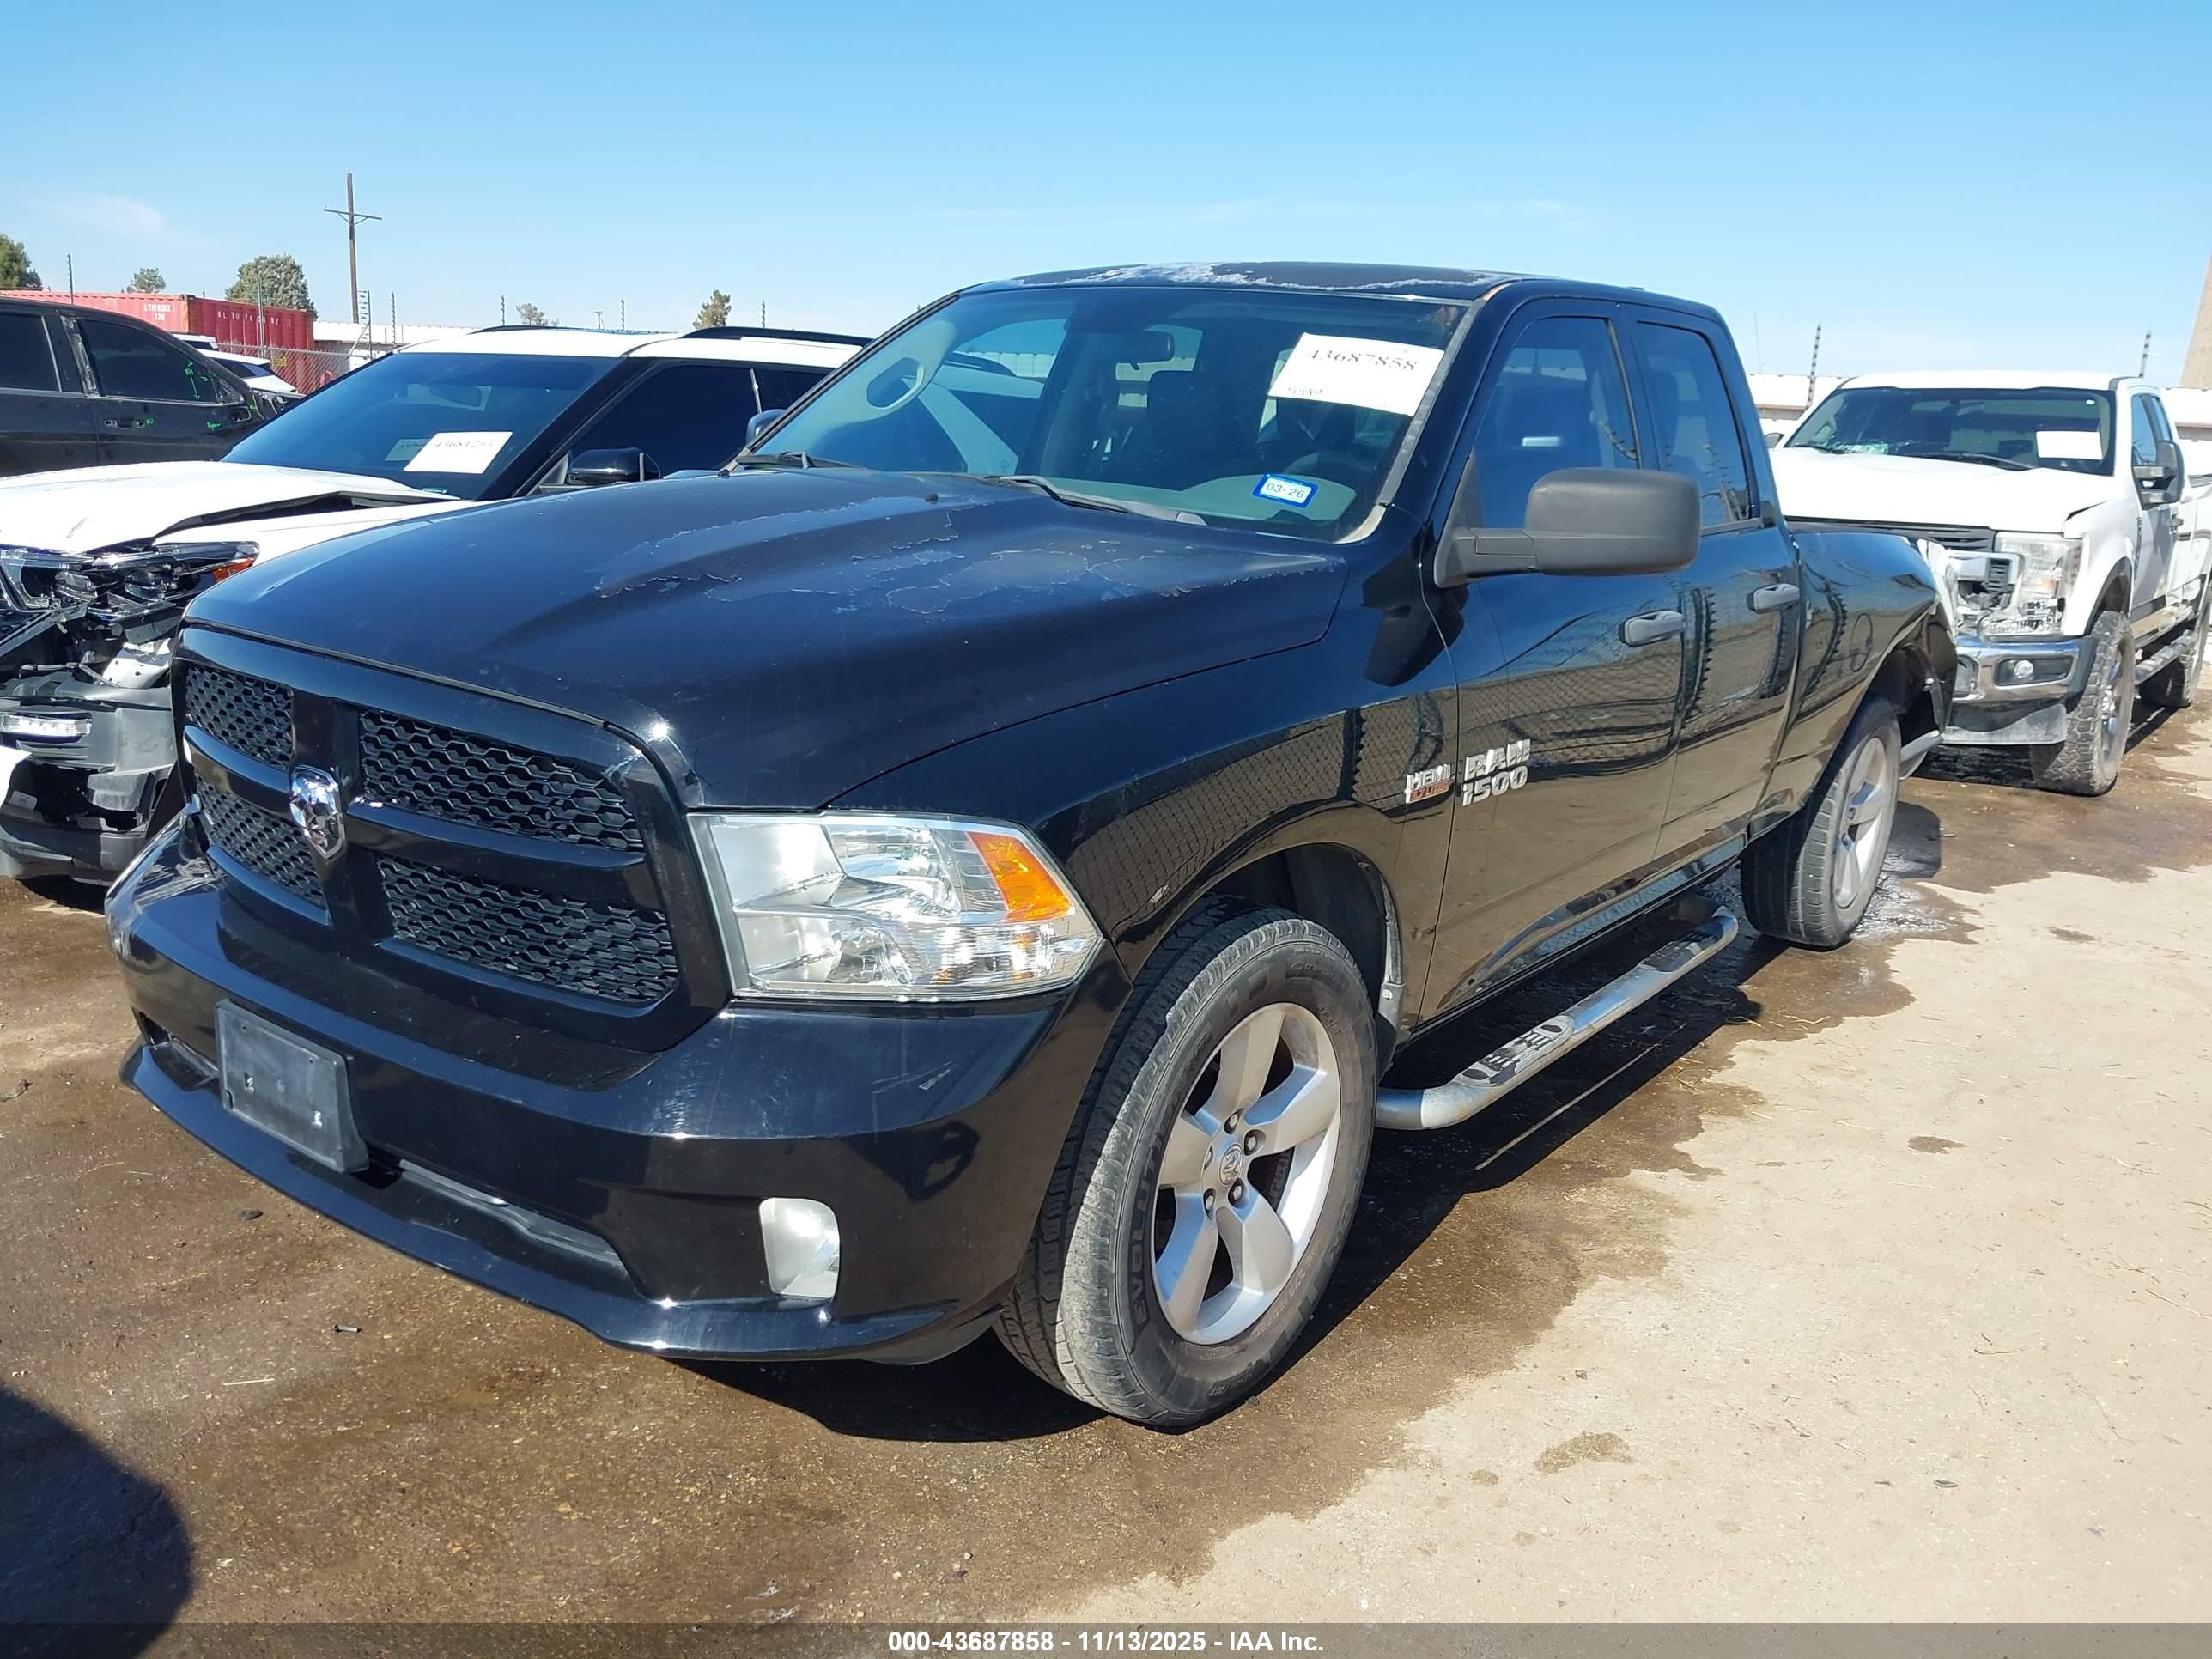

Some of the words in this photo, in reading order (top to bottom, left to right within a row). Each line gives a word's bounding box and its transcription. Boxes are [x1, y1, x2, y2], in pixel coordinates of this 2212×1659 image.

[1307, 349, 1418, 370] 43687858
[1464, 738, 1530, 781] RAM
[1407, 763, 1450, 790] HEMI
[1462, 766, 1528, 806] 1500
